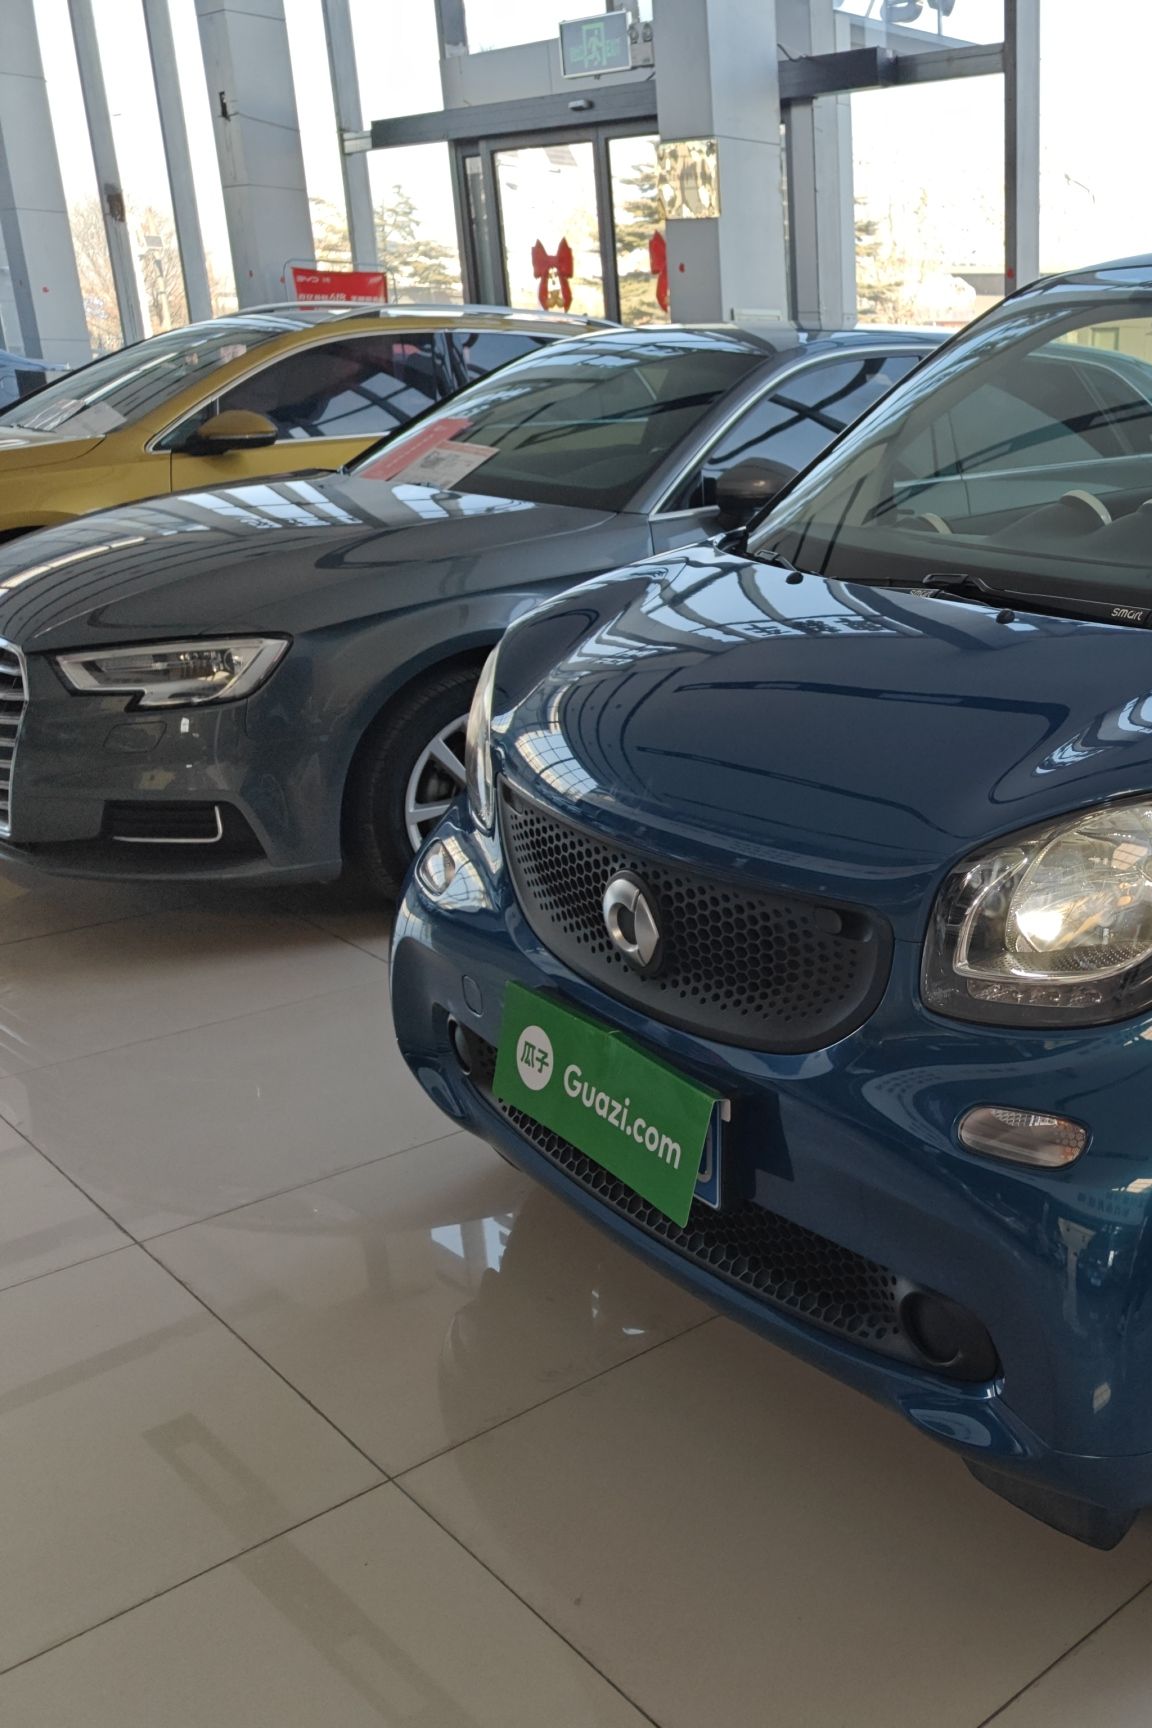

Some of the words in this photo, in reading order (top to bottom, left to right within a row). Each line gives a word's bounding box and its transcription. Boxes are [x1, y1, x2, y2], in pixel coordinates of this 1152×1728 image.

[1111, 607, 1143, 621] smart
[520, 1040, 550, 1074] 瓜子
[563, 1064, 682, 1170] Guazi.com
